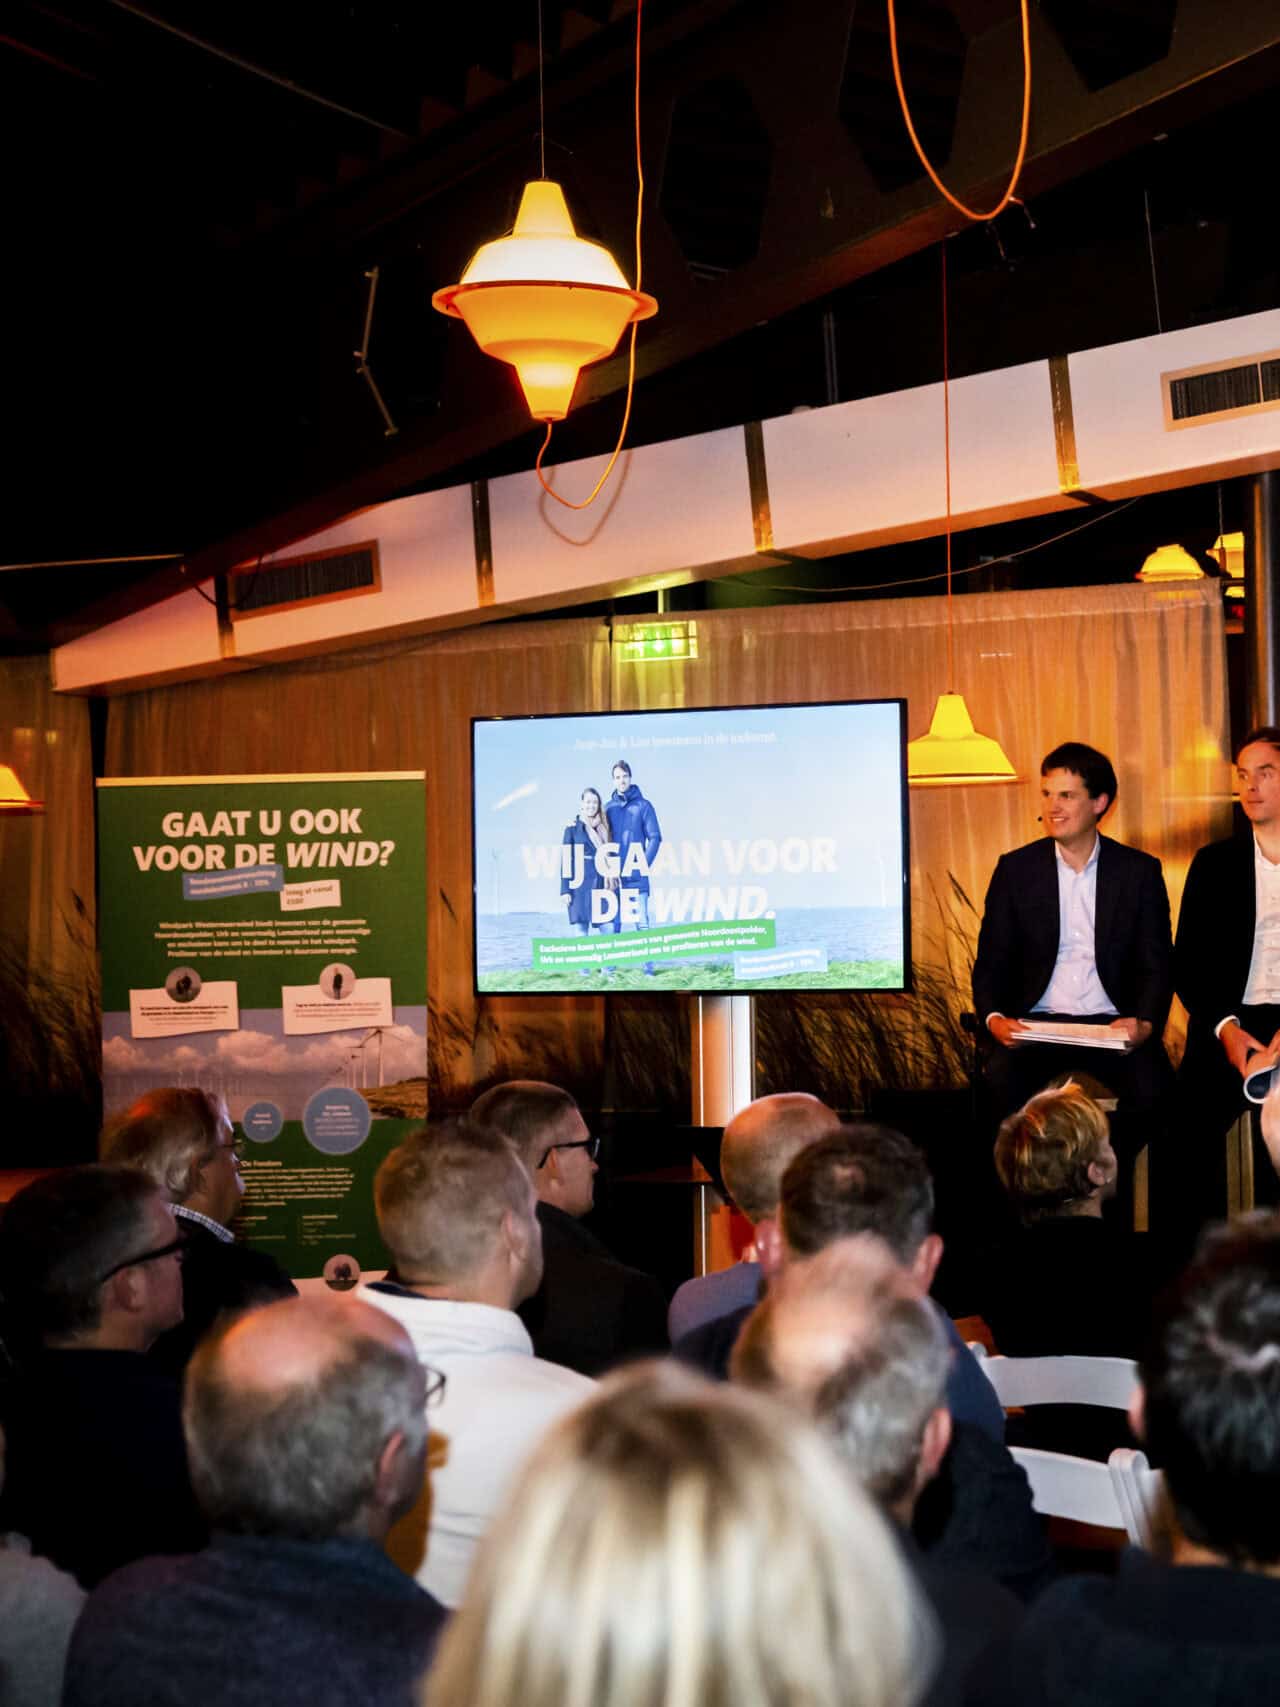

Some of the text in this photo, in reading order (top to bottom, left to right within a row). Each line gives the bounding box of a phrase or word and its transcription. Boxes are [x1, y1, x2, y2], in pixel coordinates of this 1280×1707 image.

[162, 808, 362, 838] GAAT U OOK
[133, 840, 395, 871] VOOR DE WIND?
[522, 837, 839, 889] WIJ GAAN VOOR
[591, 886, 776, 924] DE WIND.
